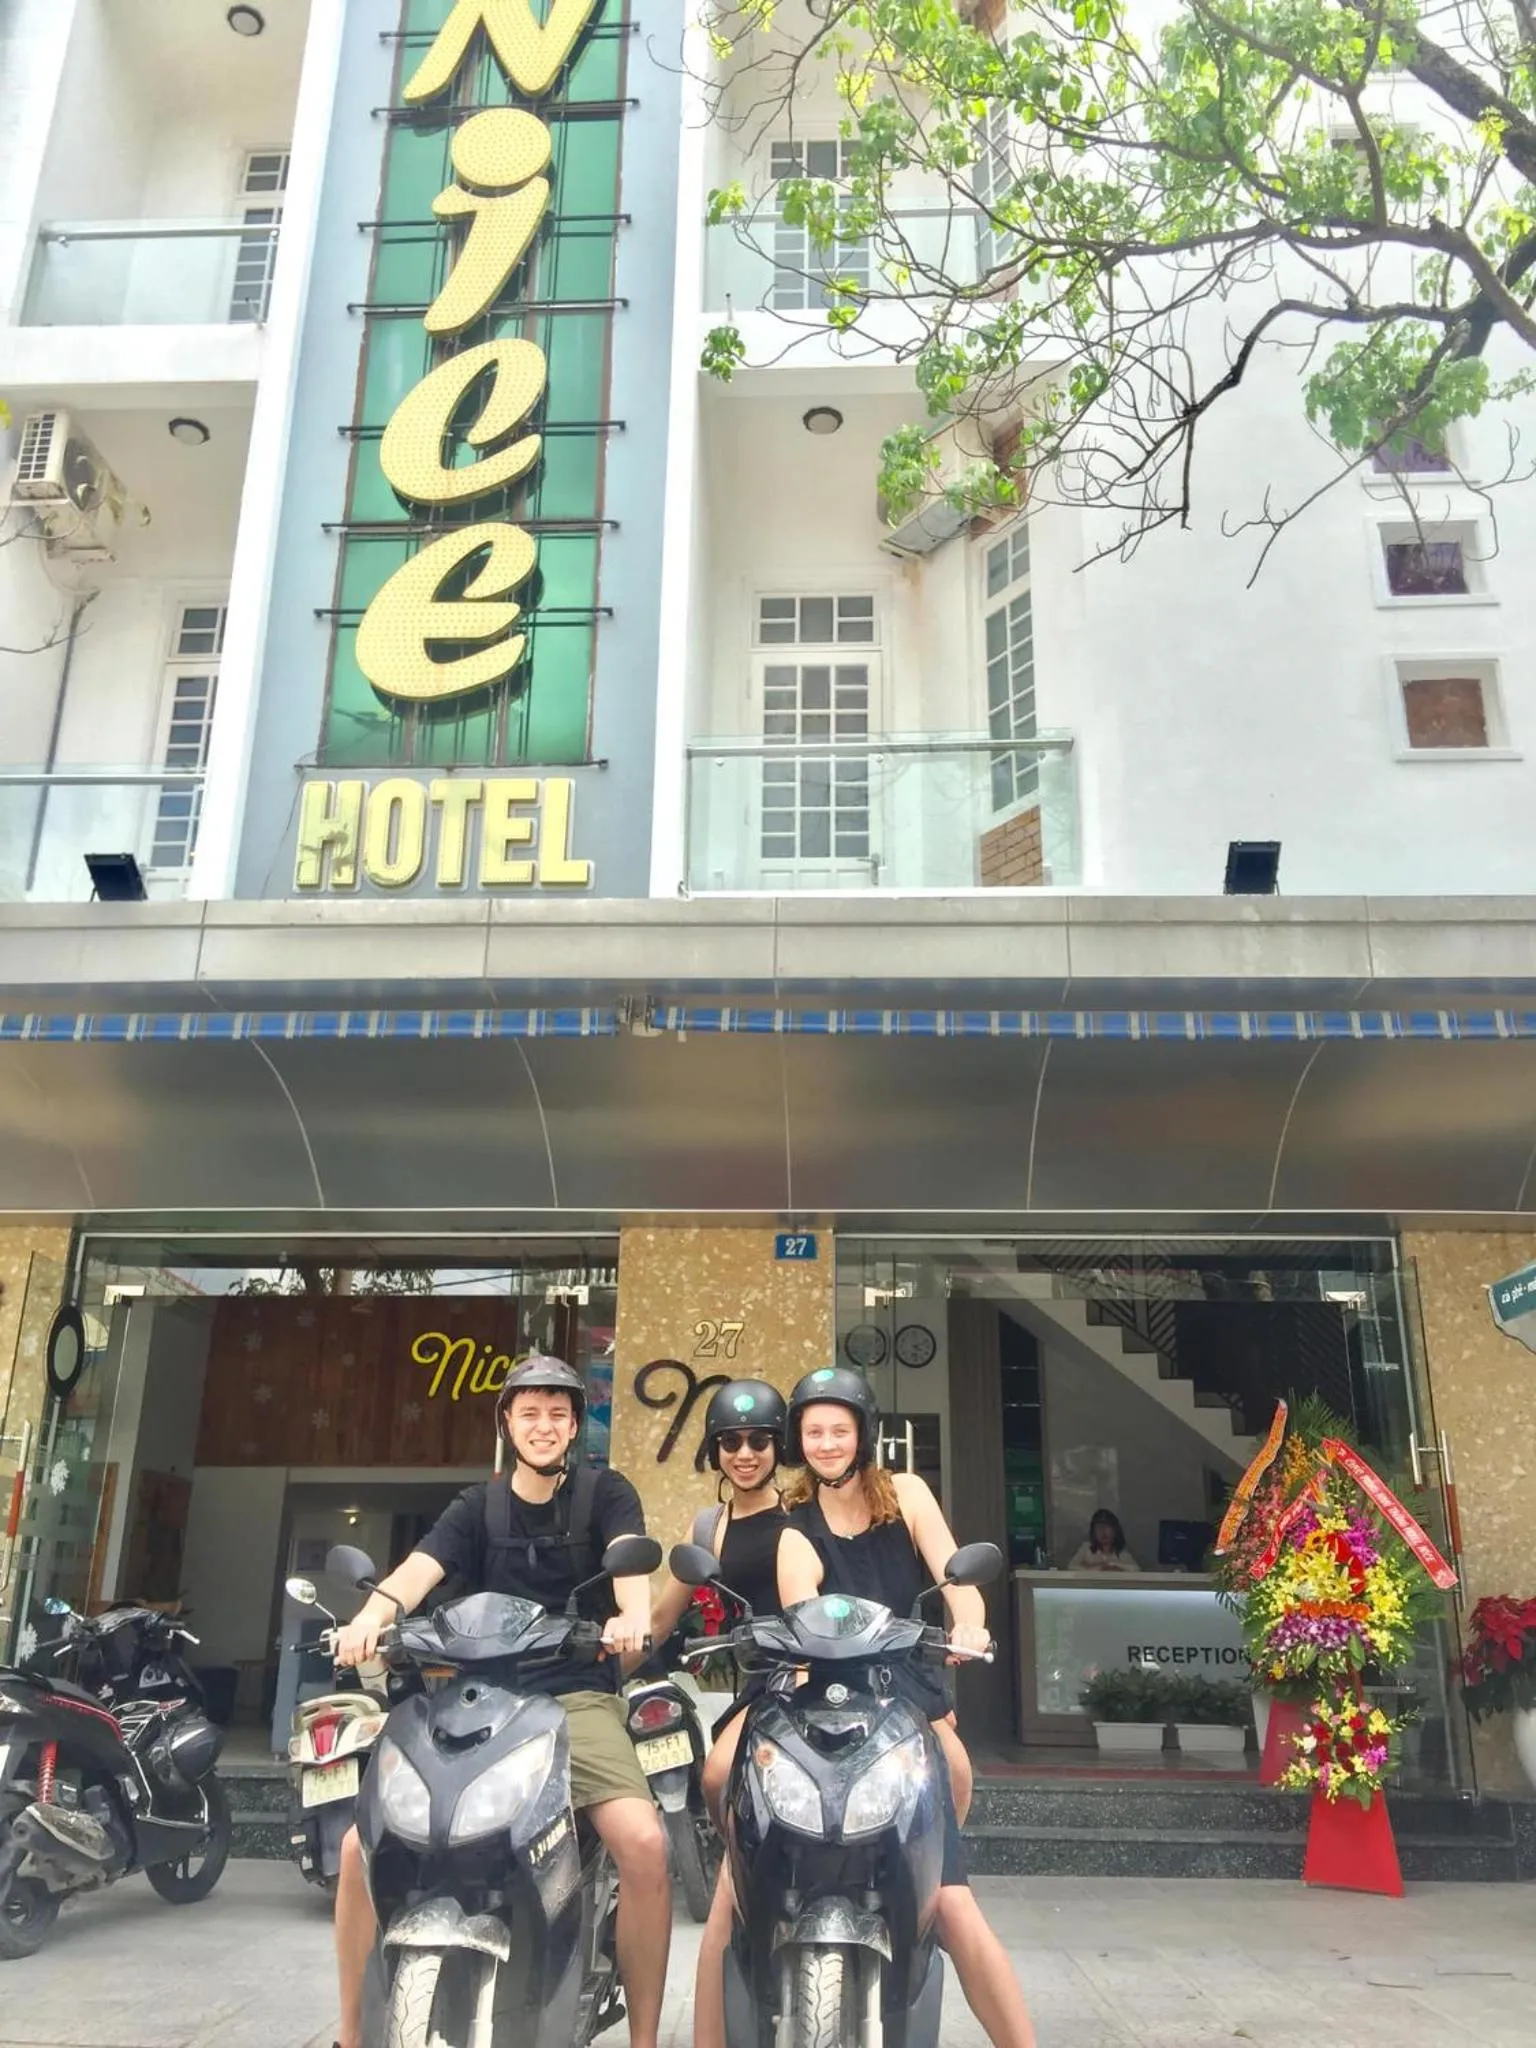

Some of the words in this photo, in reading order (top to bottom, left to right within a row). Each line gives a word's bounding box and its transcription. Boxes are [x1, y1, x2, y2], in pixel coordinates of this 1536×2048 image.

[295, 777, 592, 887] HOTEL
[785, 1237, 808, 1257] 27
[693, 1320, 745, 1359] 27
[411, 1331, 528, 1401] Nic
[1127, 1645, 1251, 1665] RECEPTION
